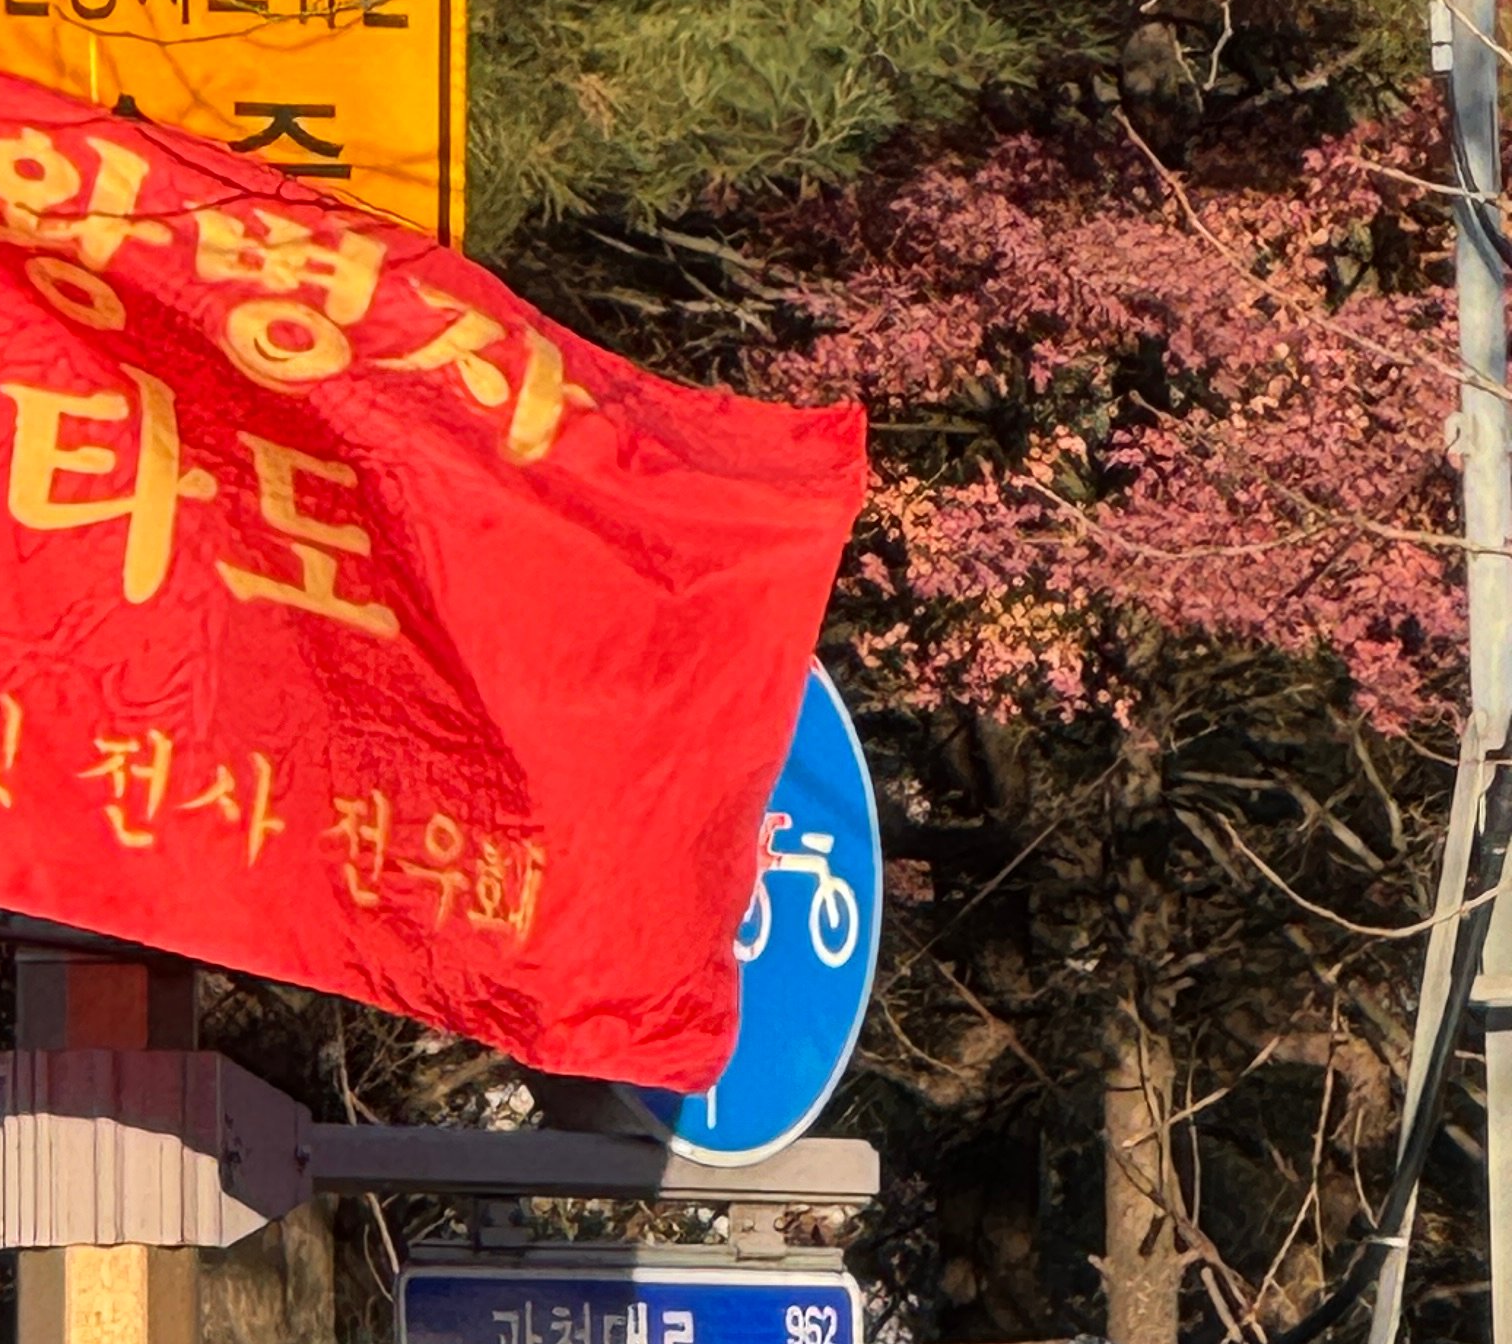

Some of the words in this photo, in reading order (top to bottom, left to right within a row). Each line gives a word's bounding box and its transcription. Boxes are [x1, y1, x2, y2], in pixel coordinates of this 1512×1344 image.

[0, 362, 402, 638] 타도
[76, 729, 286, 868] 전사
[320, 788, 546, 940] 전우회
